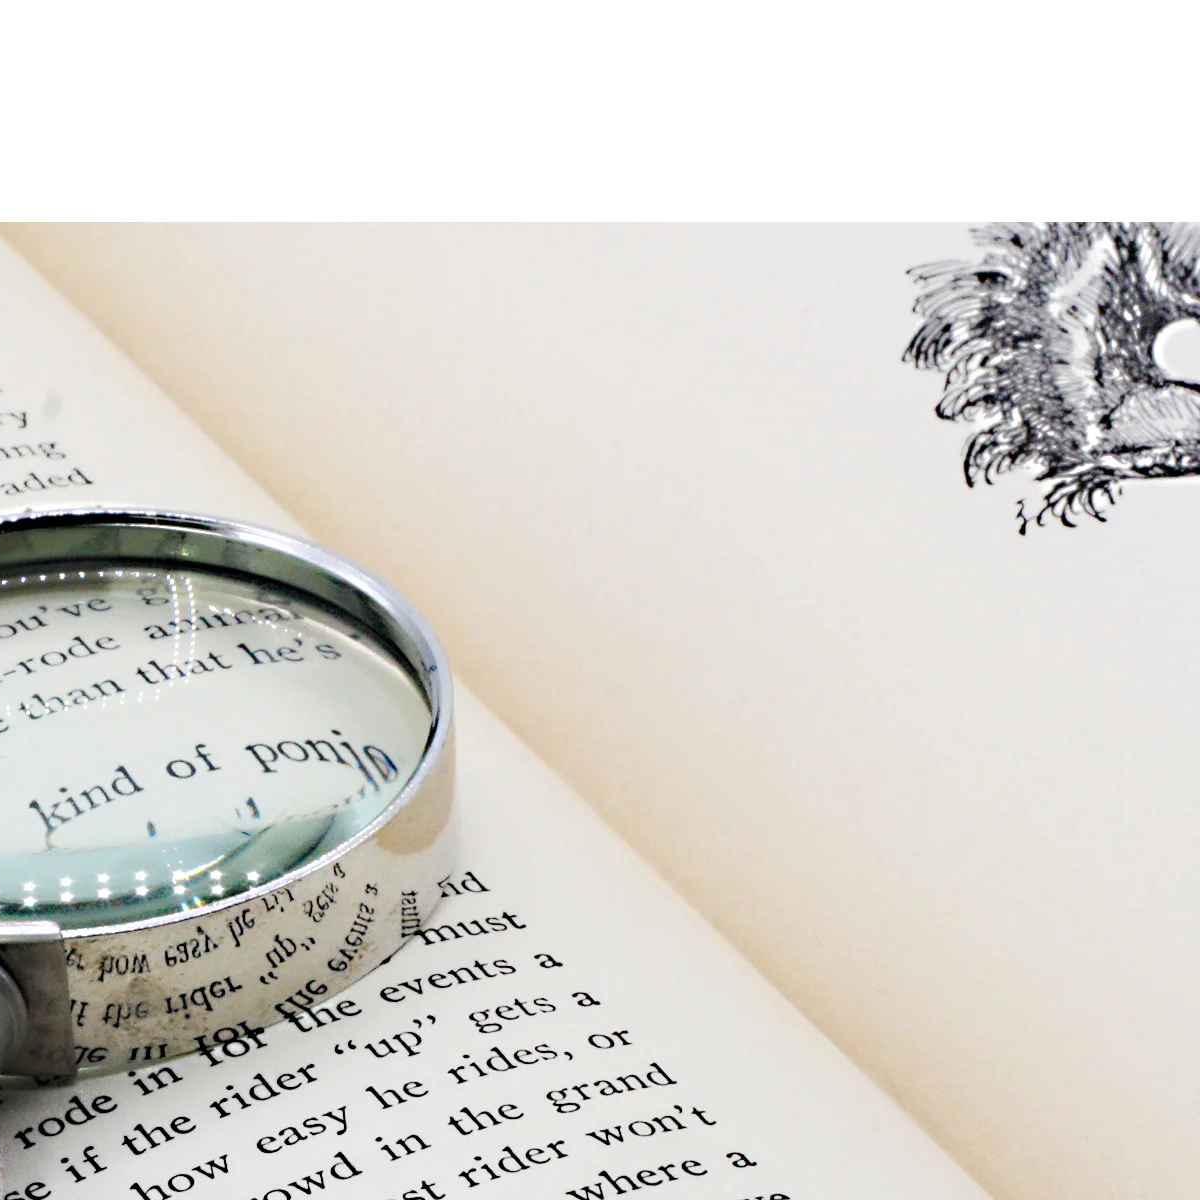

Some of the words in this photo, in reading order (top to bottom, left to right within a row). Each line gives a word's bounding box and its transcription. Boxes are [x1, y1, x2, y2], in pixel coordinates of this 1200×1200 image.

[19, 680, 125, 720] than
[136, 652, 232, 684] that
[29, 766, 144, 838] kind
[166, 744, 220, 779] of
[15, 1096, 117, 1149] rode
[380, 960, 516, 1003] events
[210, 1064, 317, 1118] rider
[469, 998, 556, 1033] gets
[257, 1106, 347, 1153] easy
[447, 1044, 573, 1084] rides,
[546, 1062, 677, 1113] grand
[458, 1140, 568, 1188] rider
